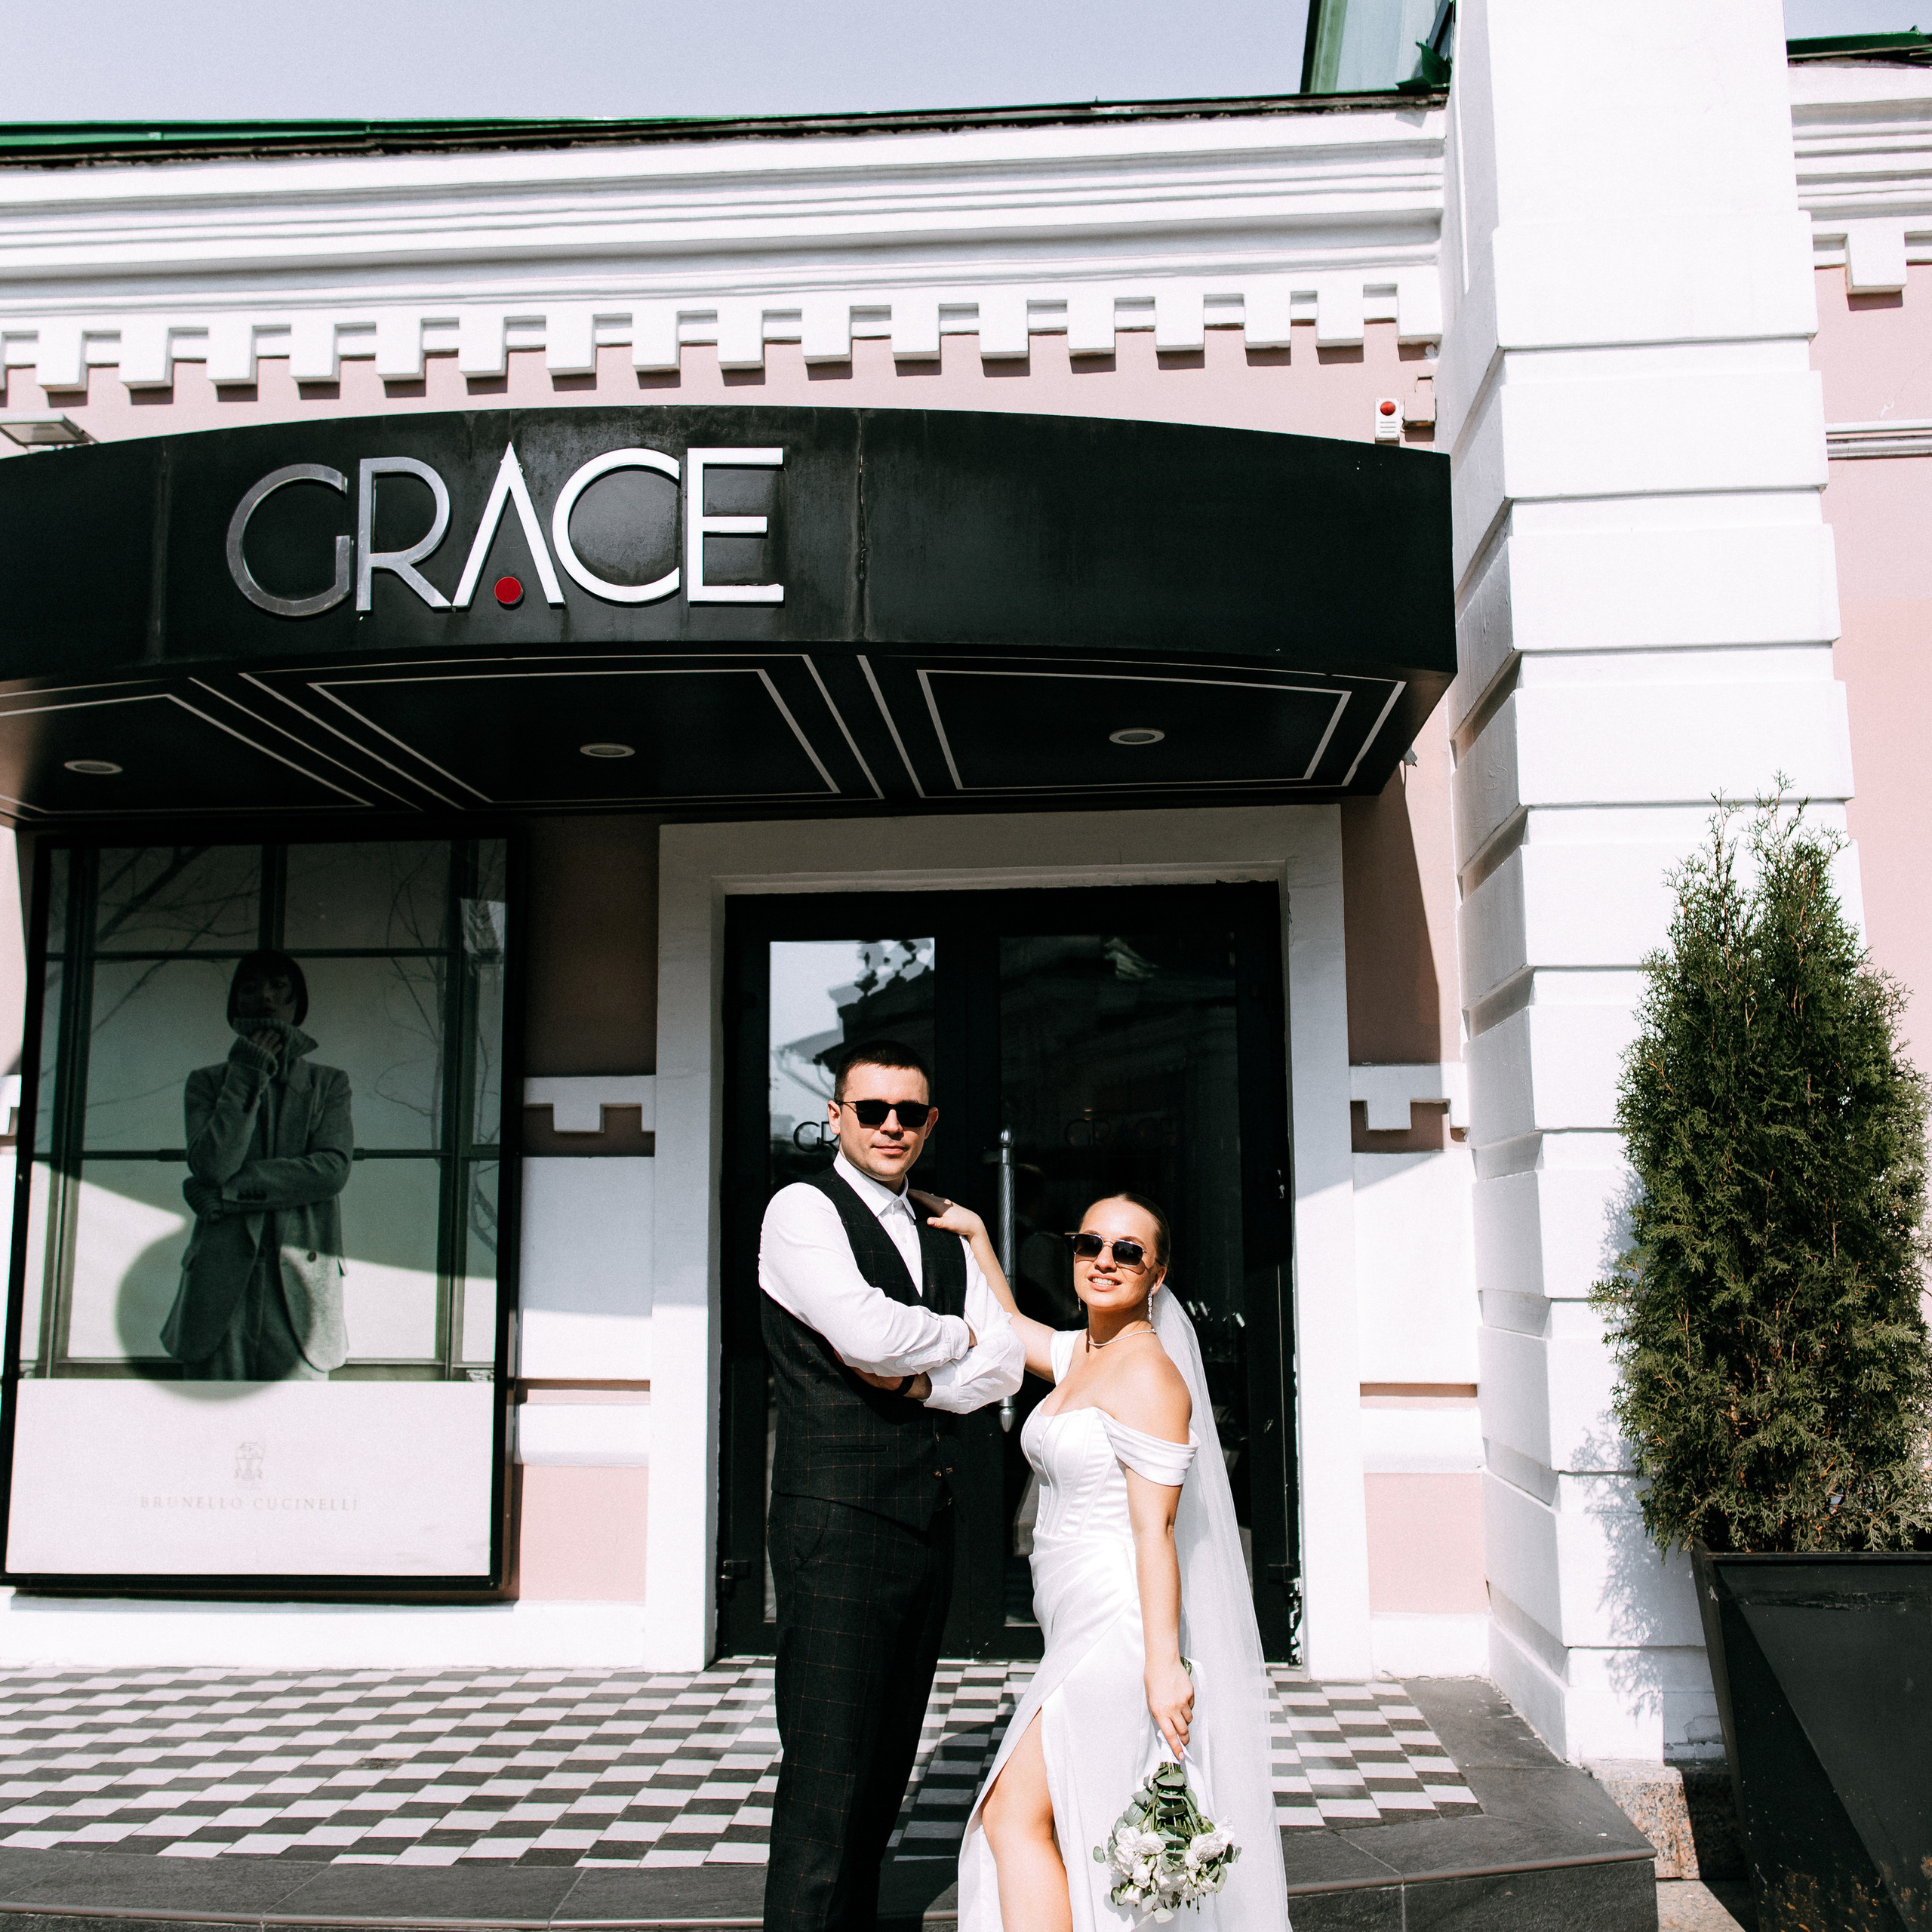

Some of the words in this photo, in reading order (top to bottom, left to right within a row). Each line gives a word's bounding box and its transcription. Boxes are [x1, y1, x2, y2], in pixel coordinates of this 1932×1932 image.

[226, 441, 785, 617] GRACE
[793, 1121, 841, 1154] GR
[140, 1495, 244, 1510] BRUNELLO
[253, 1497, 358, 1512] CUCINELLI
